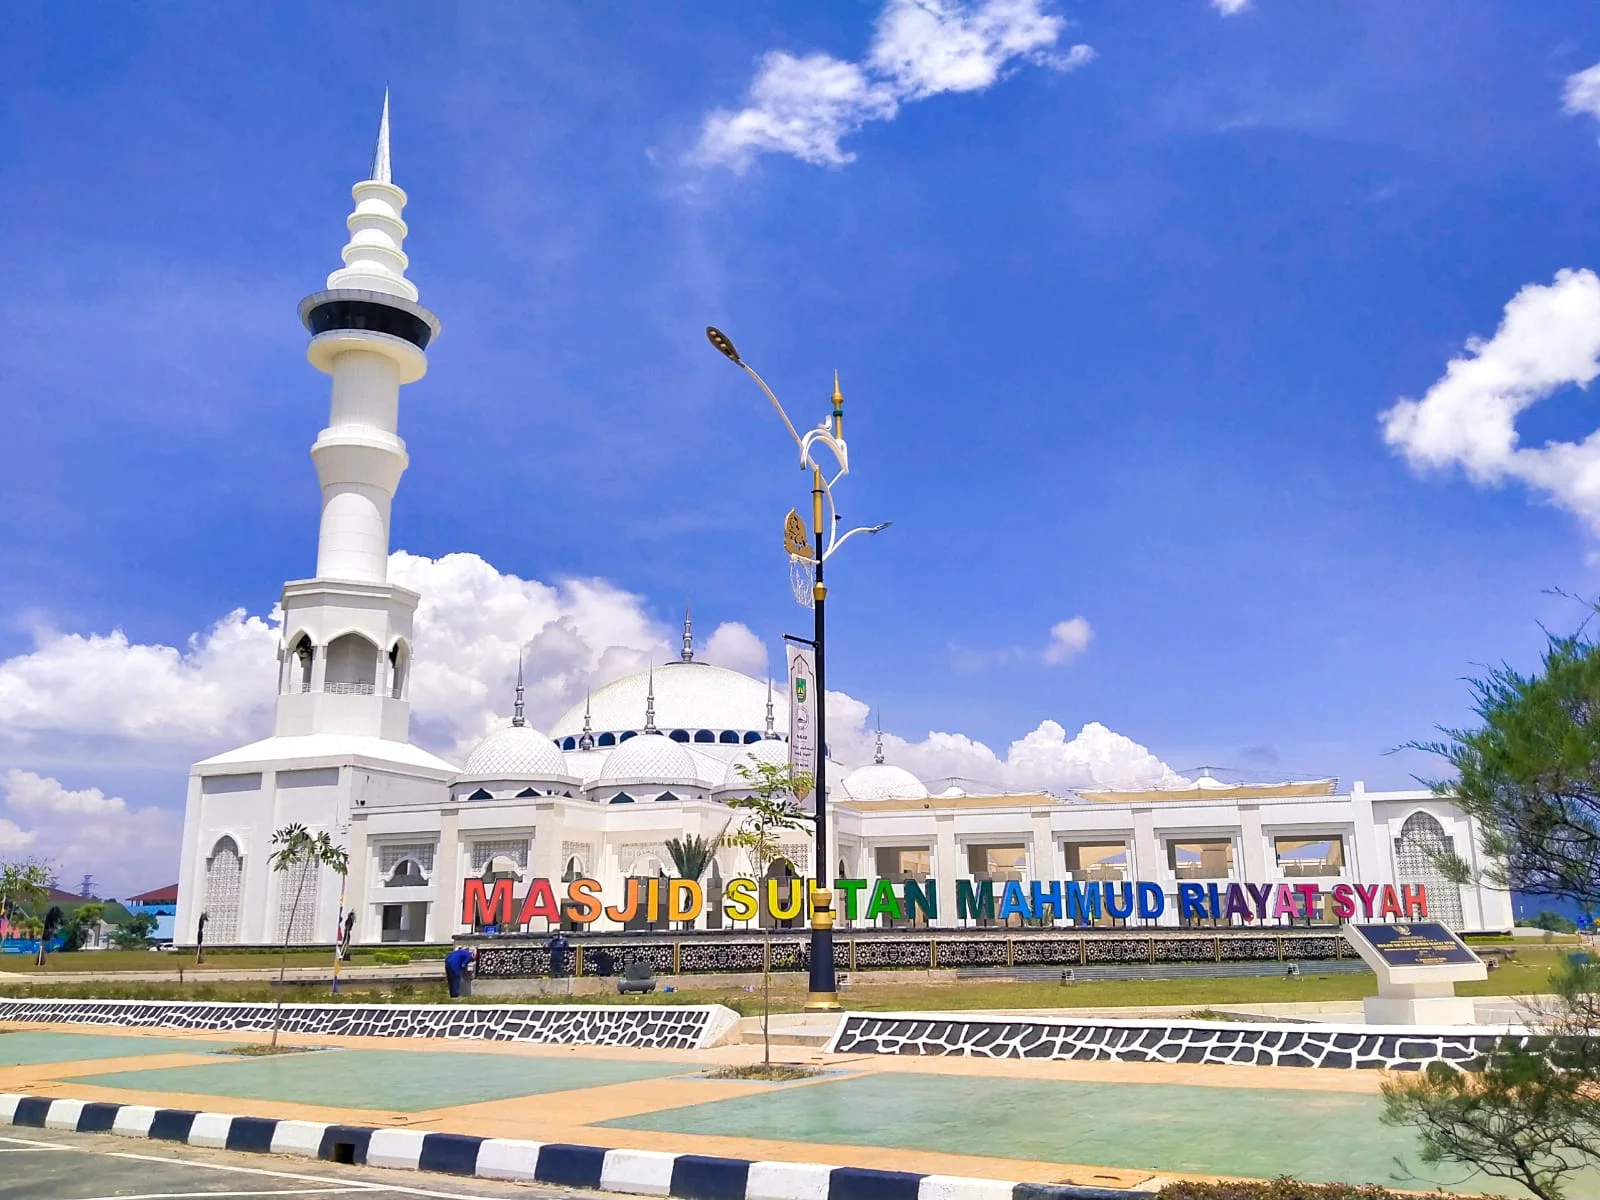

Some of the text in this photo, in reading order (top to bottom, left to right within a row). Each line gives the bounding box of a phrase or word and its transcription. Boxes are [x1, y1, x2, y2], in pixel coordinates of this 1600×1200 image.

[463, 878, 703, 924] MASJID
[956, 879, 1165, 920] MAHMUD
[1179, 882, 1320, 921] RIAYAT
[1332, 883, 1428, 919] SYAH
